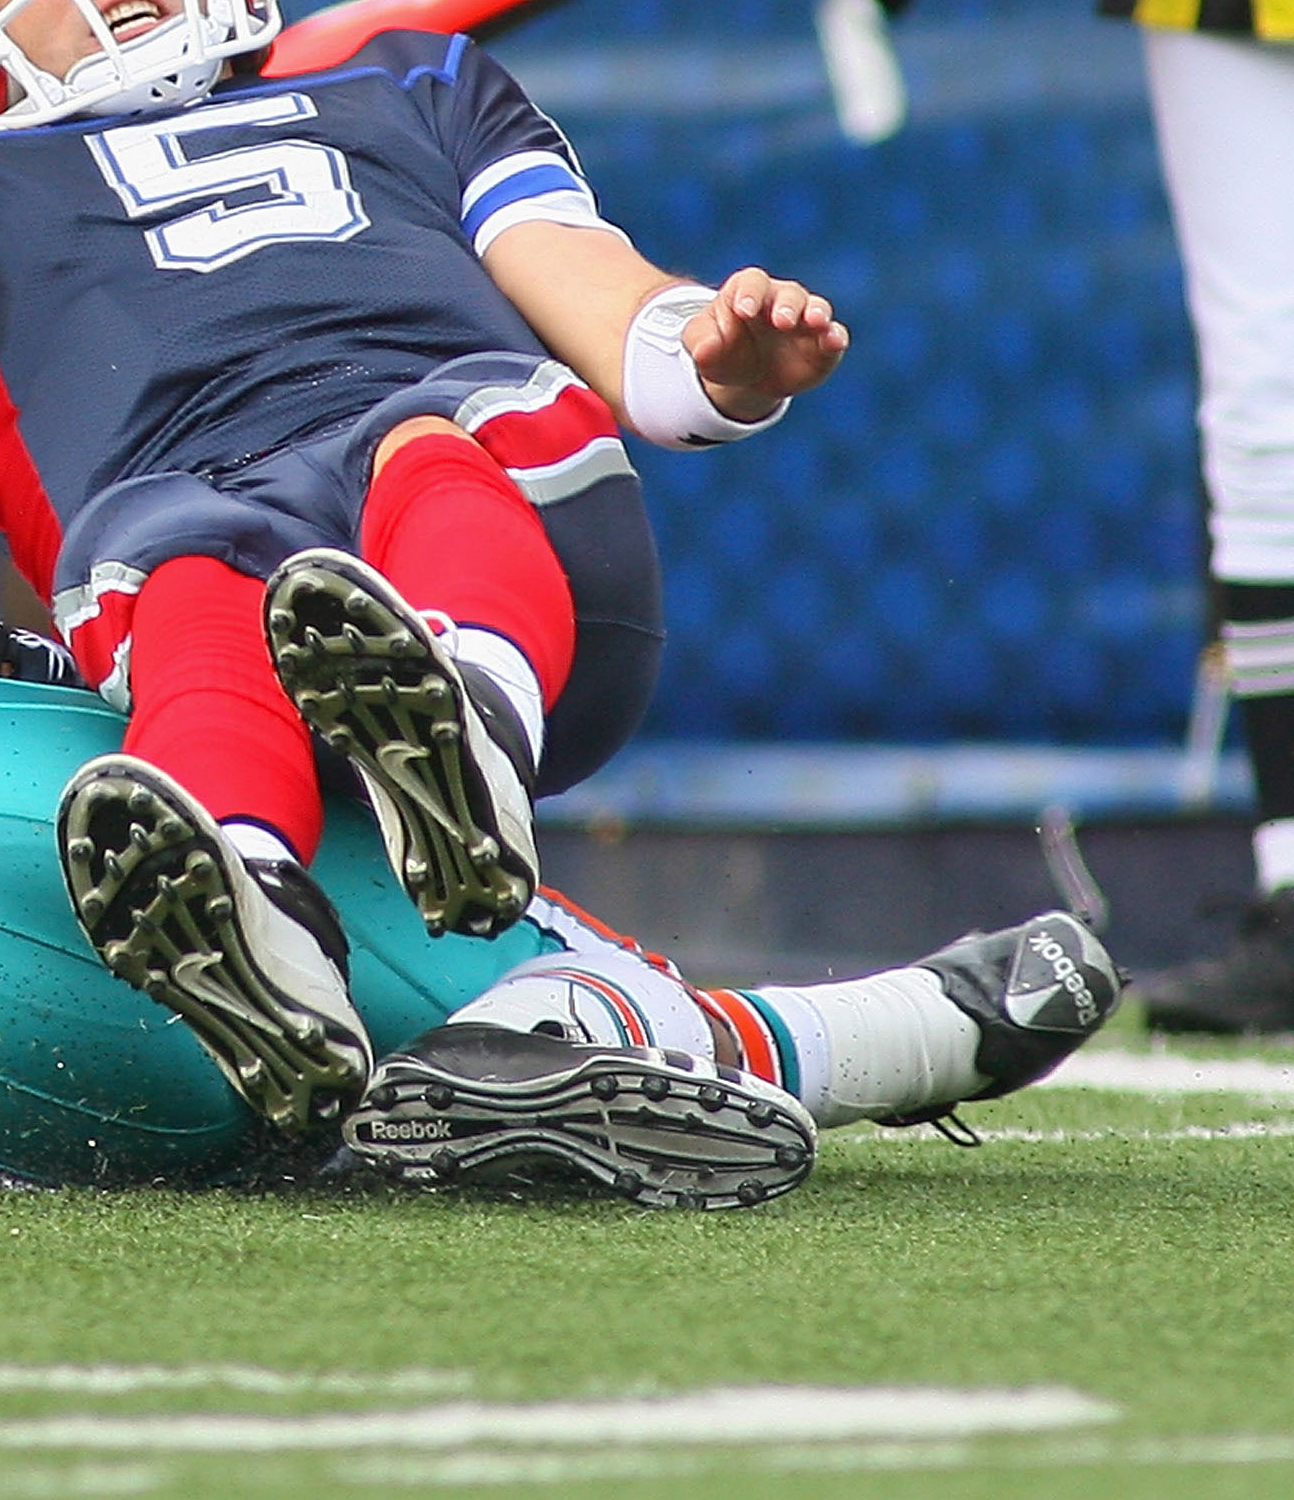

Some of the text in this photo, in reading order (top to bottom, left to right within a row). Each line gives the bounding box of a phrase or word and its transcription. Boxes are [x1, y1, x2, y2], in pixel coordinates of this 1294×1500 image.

[83, 92, 371, 273] 5
[1029, 932, 1099, 1025] Reebok
[371, 1119, 452, 1138] Reebok
